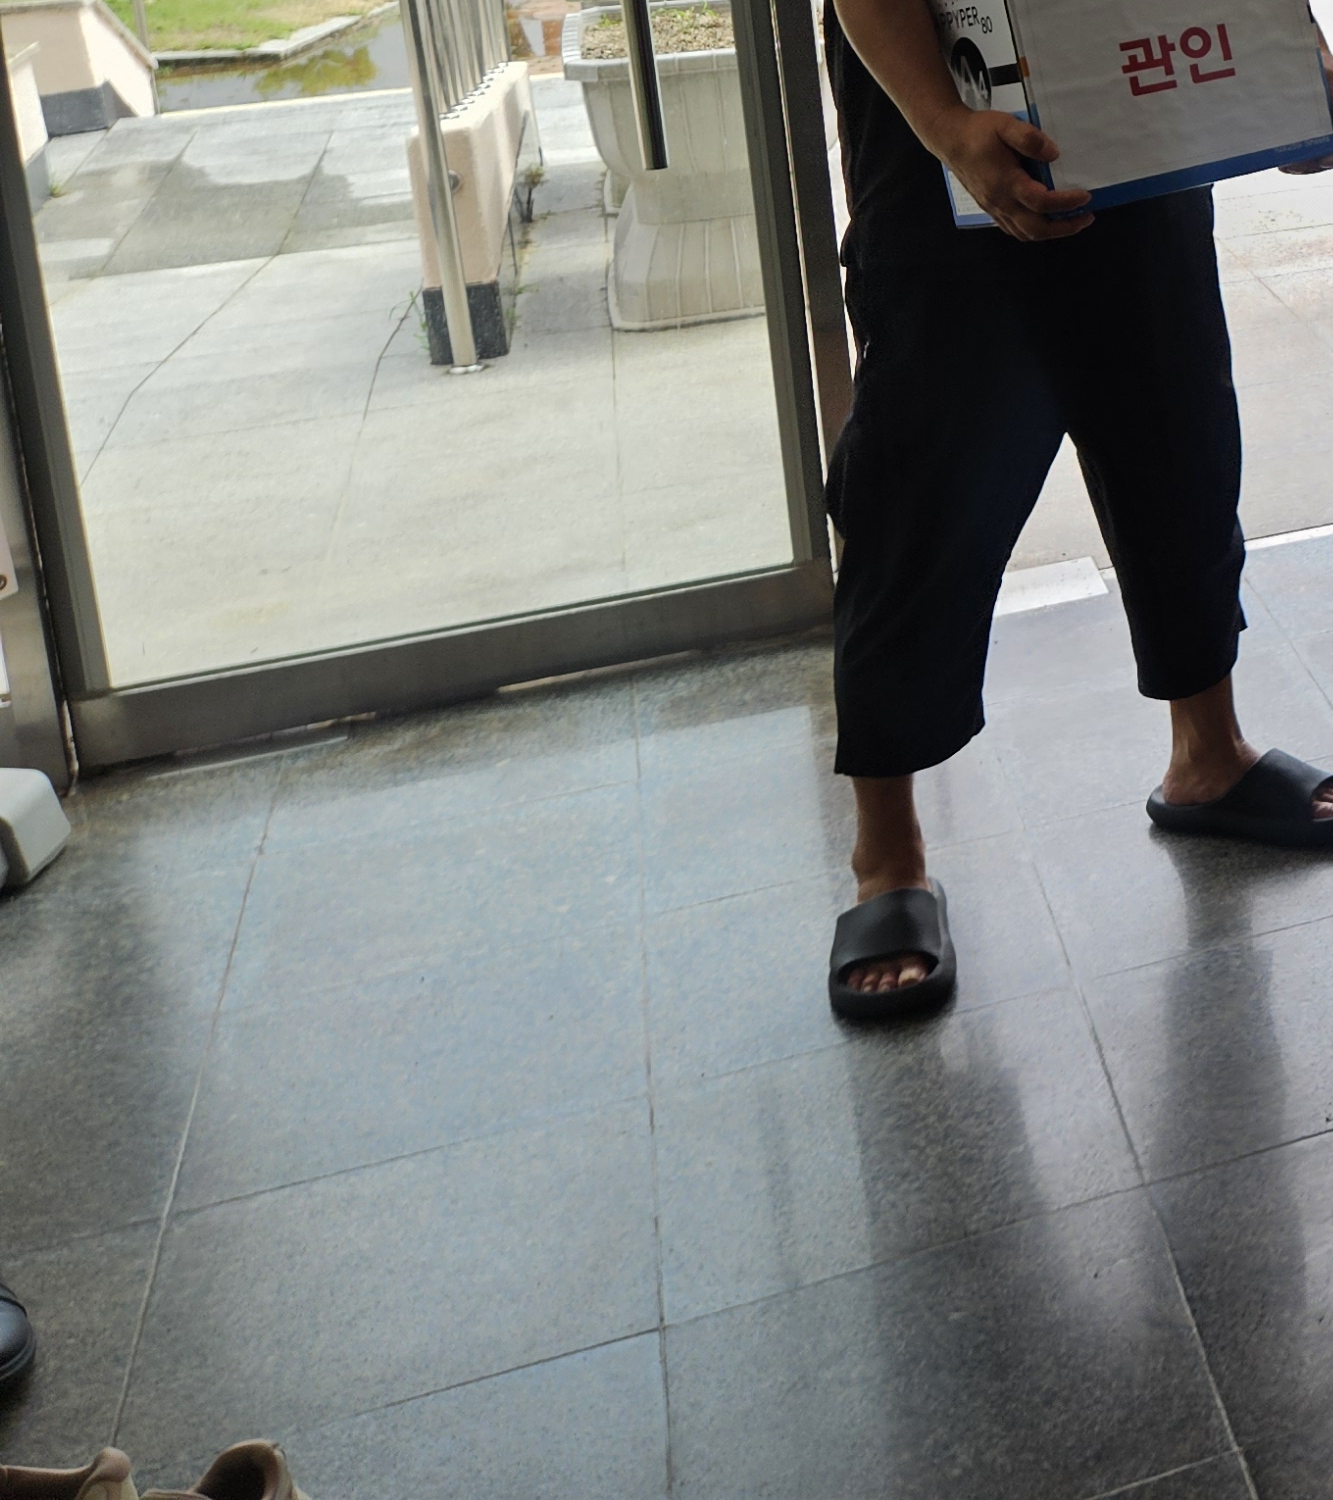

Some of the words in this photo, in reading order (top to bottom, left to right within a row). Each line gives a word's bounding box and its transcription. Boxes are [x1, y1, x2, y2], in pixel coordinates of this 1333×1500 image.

[939, 6, 981, 31] PPYPER
[980, 15, 993, 34] 80
[1119, 22, 1237, 97] 관인
